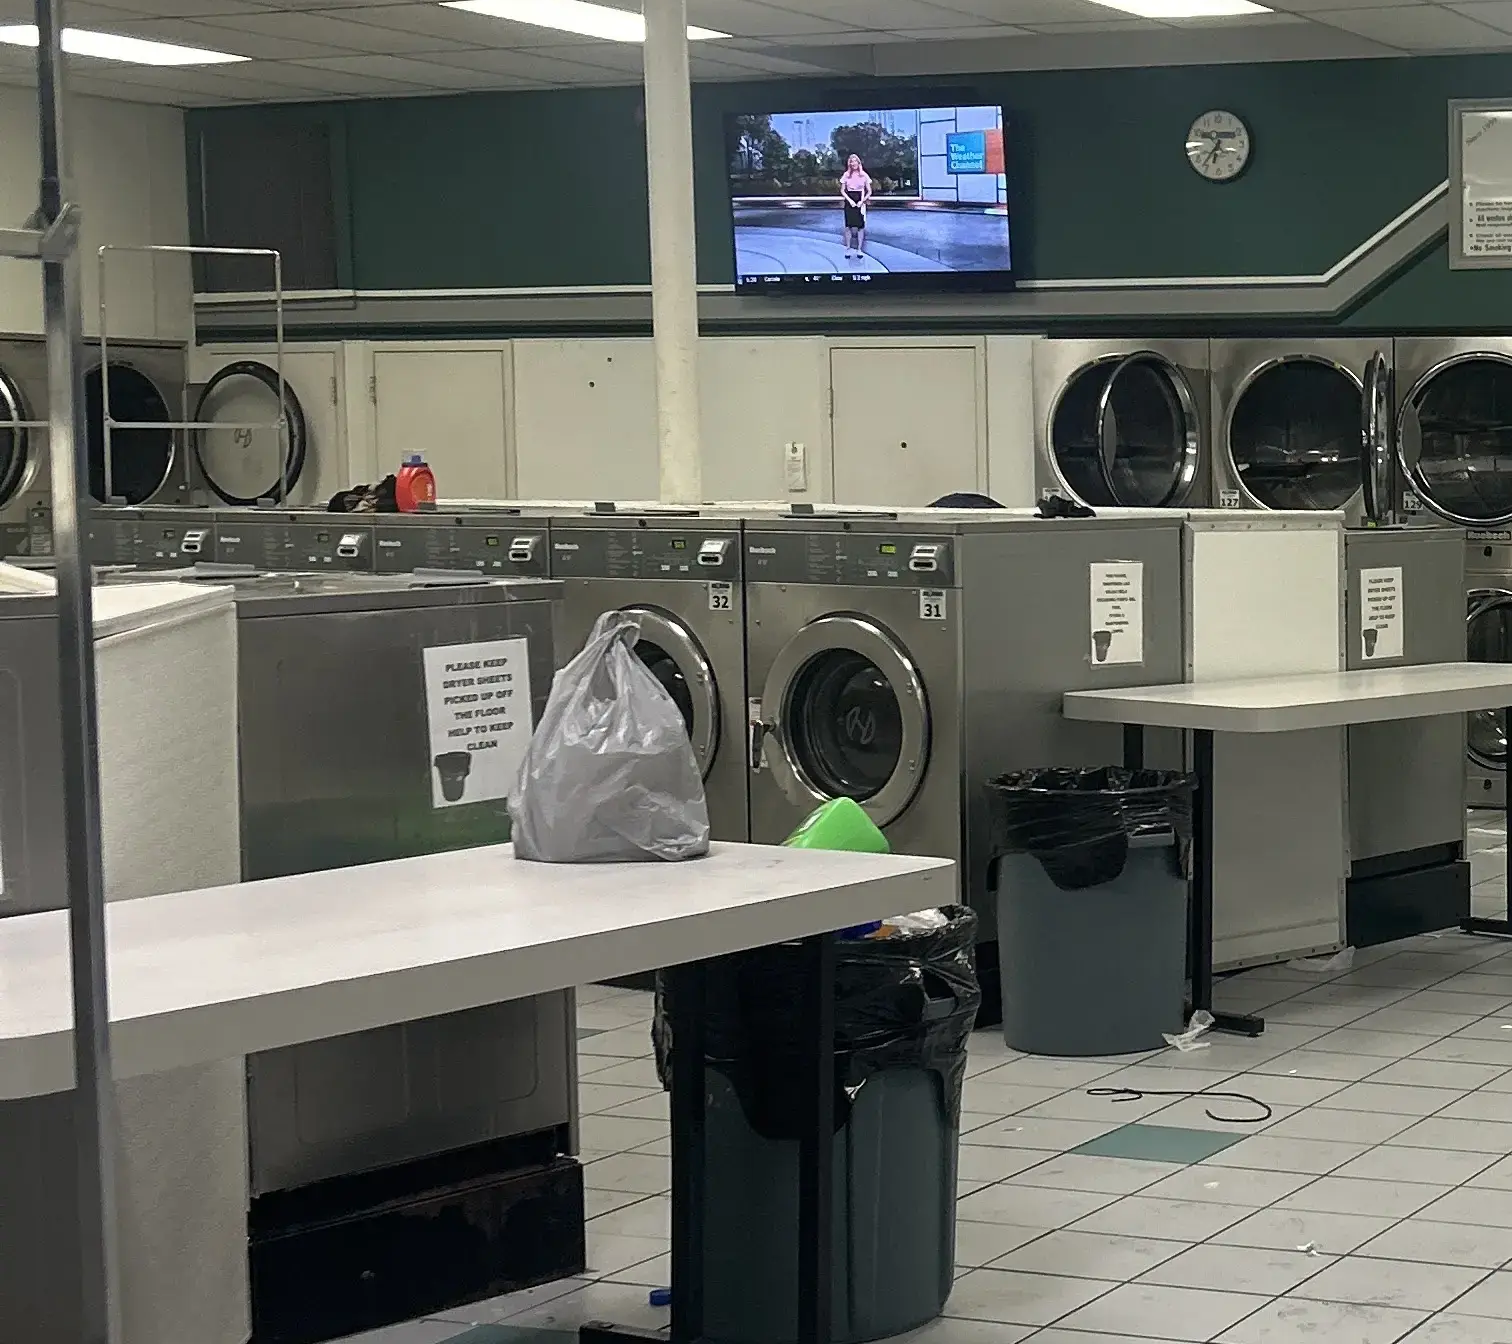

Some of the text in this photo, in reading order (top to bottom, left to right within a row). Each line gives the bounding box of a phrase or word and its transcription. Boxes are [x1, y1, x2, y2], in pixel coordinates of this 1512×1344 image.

[950, 144, 965, 152] The
[951, 152, 982, 160] Weather
[951, 160, 982, 169] Channel
[1485, 244, 1511, 252] Smoking
[1222, 498, 1238, 506] 127
[712, 595, 729, 608] 32
[924, 604, 942, 617] 31
[446, 658, 508, 672] PLEASE KEEP
[443, 674, 512, 688] DRYER SHEETS
[444, 690, 513, 705] PICKED UP OFF
[454, 707, 506, 720] THE FLOOR
[448, 722, 514, 737] HELP TO KEEP
[467, 740, 498, 750] CLEAN
